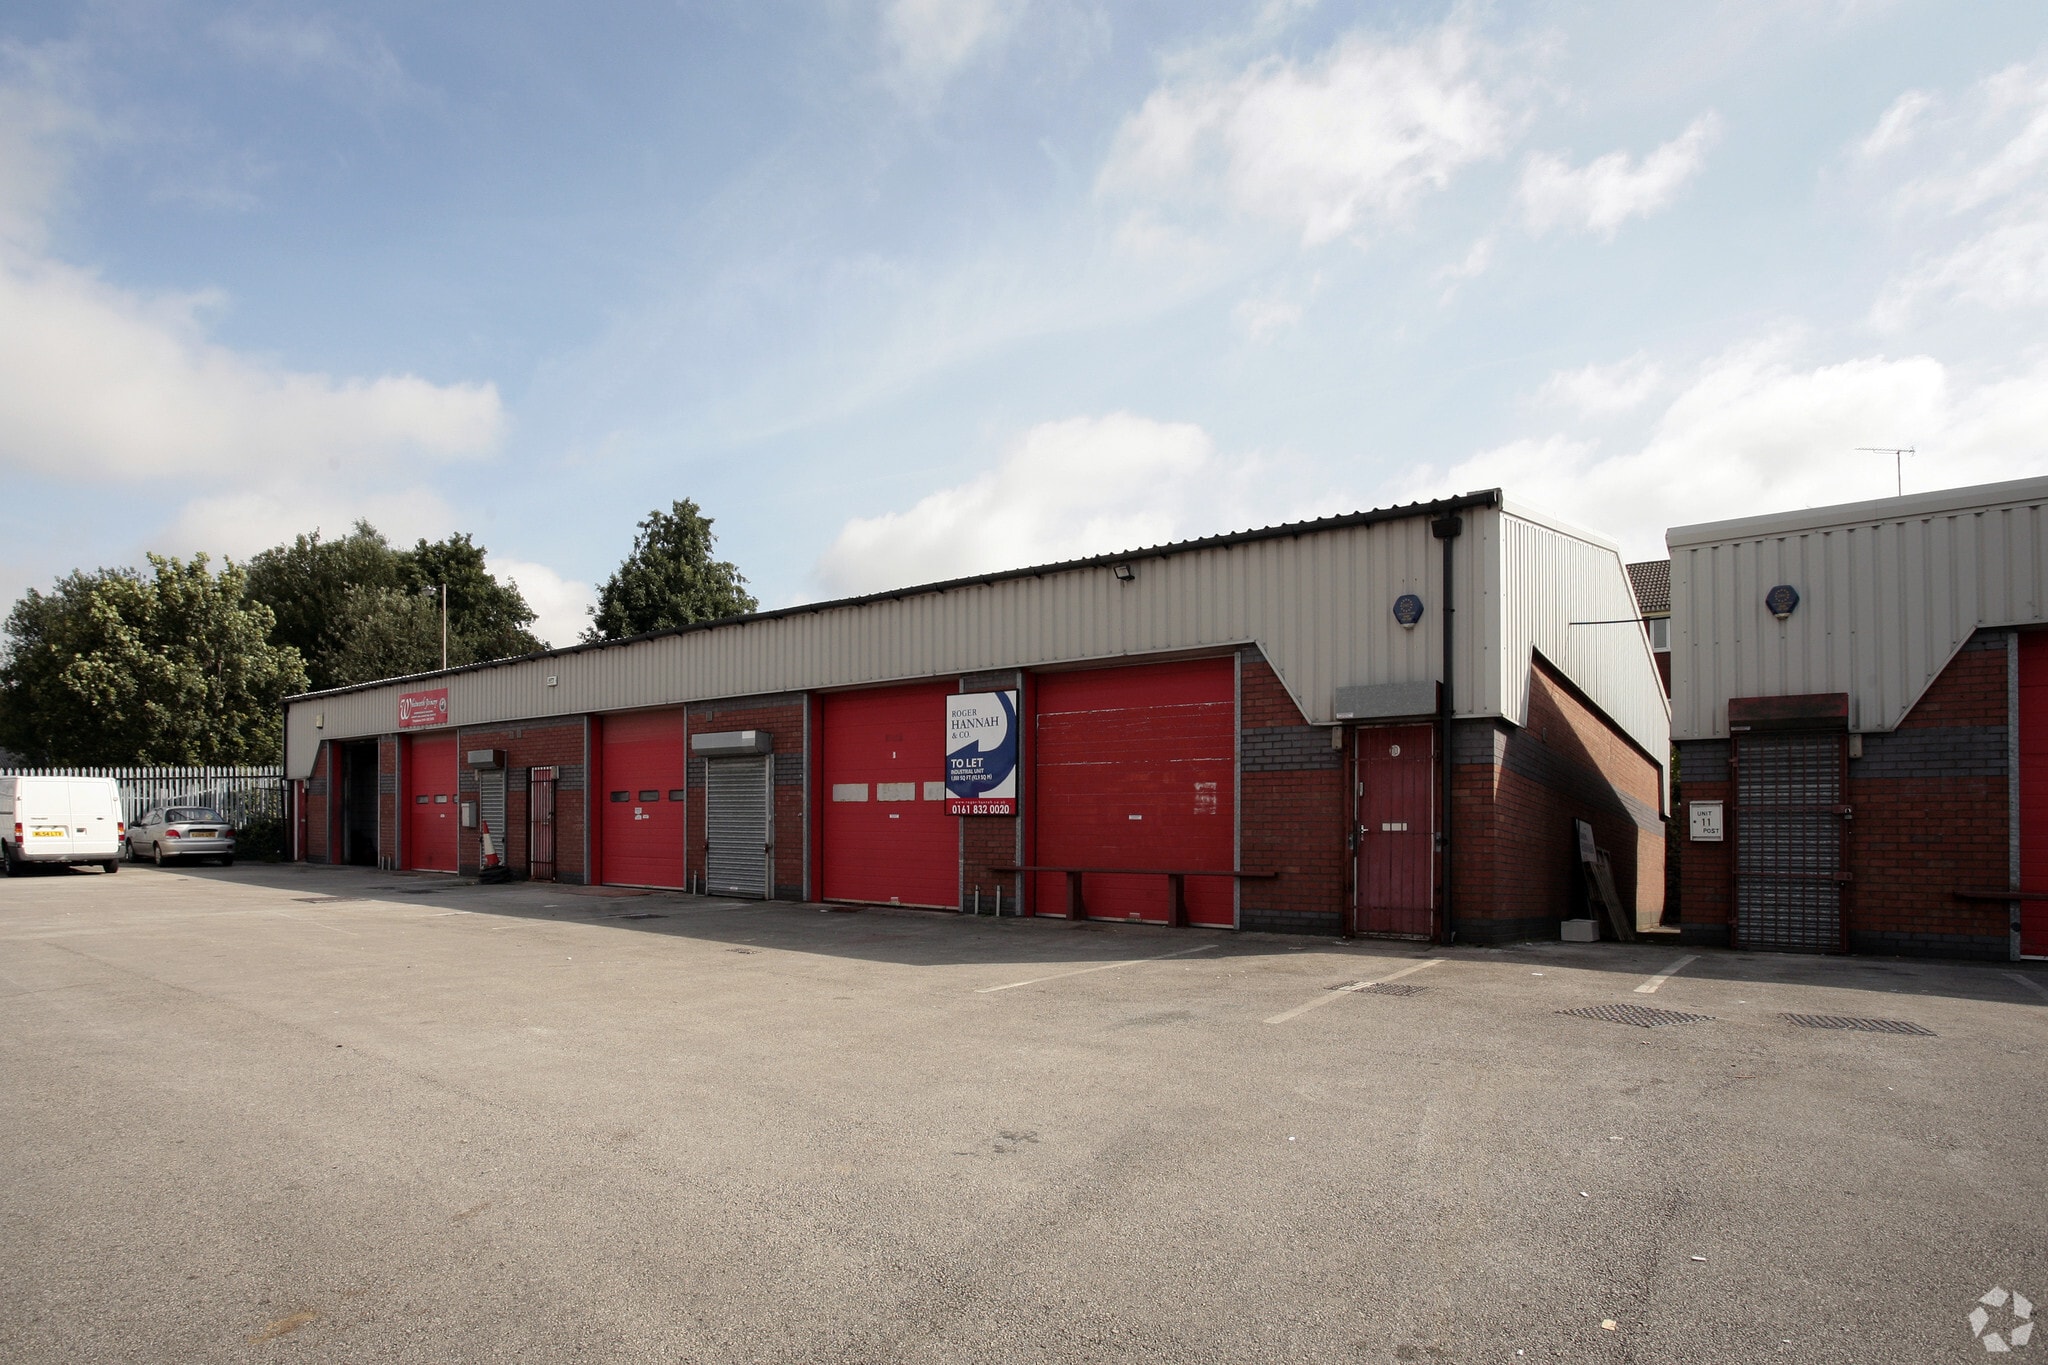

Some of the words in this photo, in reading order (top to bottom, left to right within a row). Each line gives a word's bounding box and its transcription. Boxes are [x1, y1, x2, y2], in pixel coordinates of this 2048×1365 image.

[952, 708, 977, 718] ROGER
[951, 716, 999, 730] HANNAH
[950, 758, 964, 768] TO
[966, 758, 984, 768] LET
[952, 805, 970, 814] 0161
[973, 805, 988, 814] 832
[990, 805, 1010, 814] 0020
[1702, 818, 1710, 826] 11
